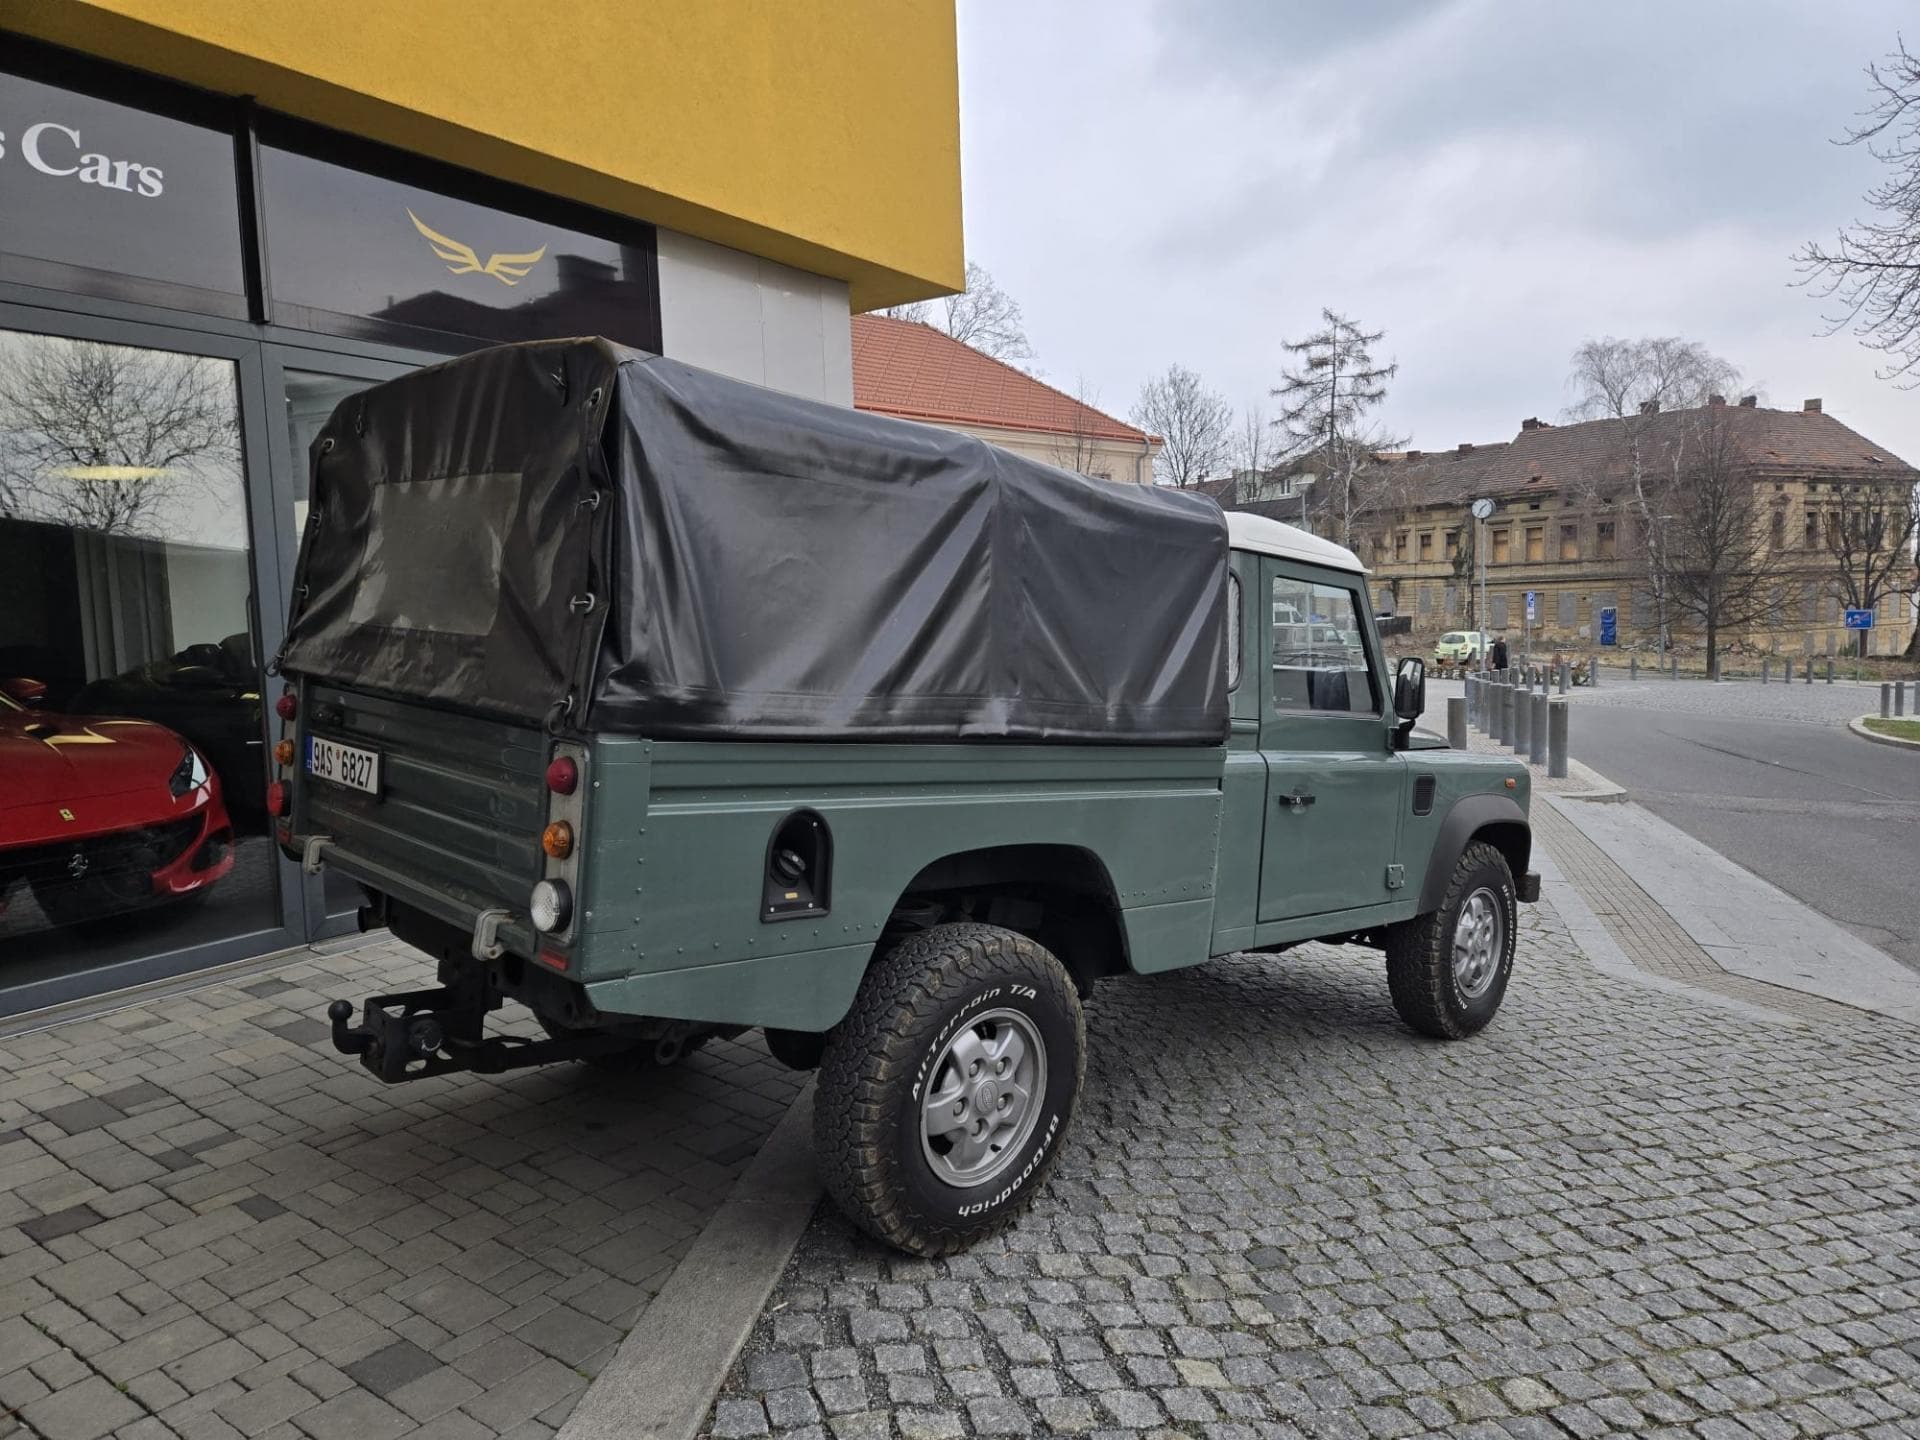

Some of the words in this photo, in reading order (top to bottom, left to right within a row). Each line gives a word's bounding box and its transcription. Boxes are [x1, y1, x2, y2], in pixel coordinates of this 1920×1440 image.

[21, 122, 164, 198] Cars
[313, 742, 333, 776] 9AS
[341, 750, 373, 788] 6827
[912, 988, 1001, 1102] All-Terrain
[1010, 984, 1038, 1000] T/A
[958, 1113, 1059, 1217] BFGoodrich
